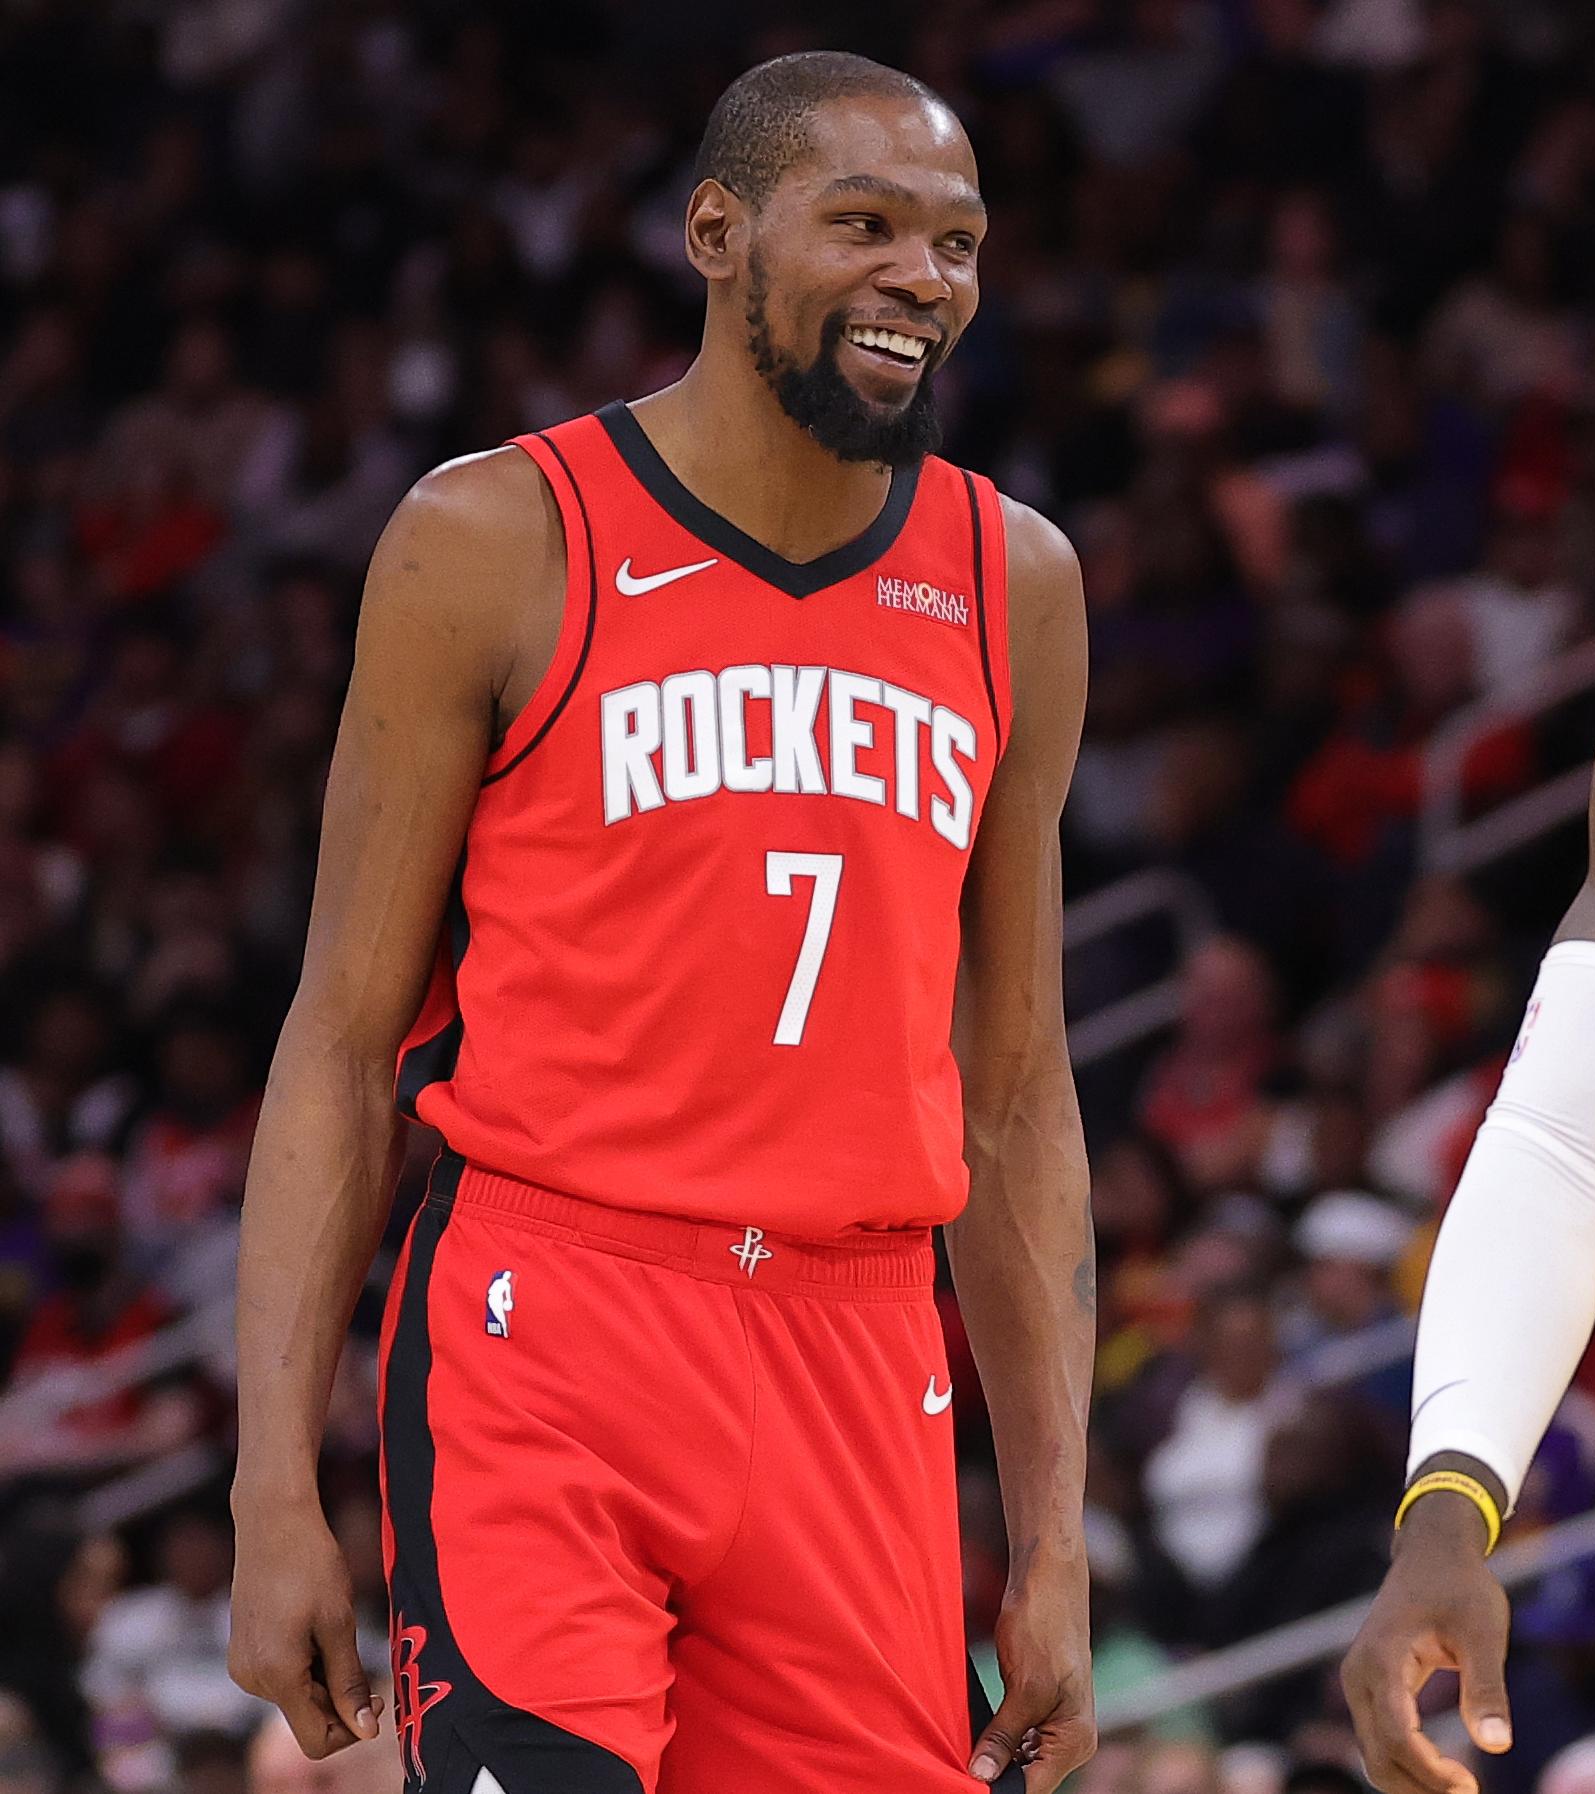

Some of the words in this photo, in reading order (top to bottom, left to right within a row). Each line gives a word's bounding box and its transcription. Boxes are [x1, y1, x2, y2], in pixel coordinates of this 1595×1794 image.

[877, 575, 968, 612] MEMORIAL
[877, 588, 968, 626] HERMANN
[600, 664, 977, 851] ROCKETS
[764, 850, 845, 1047] 7
